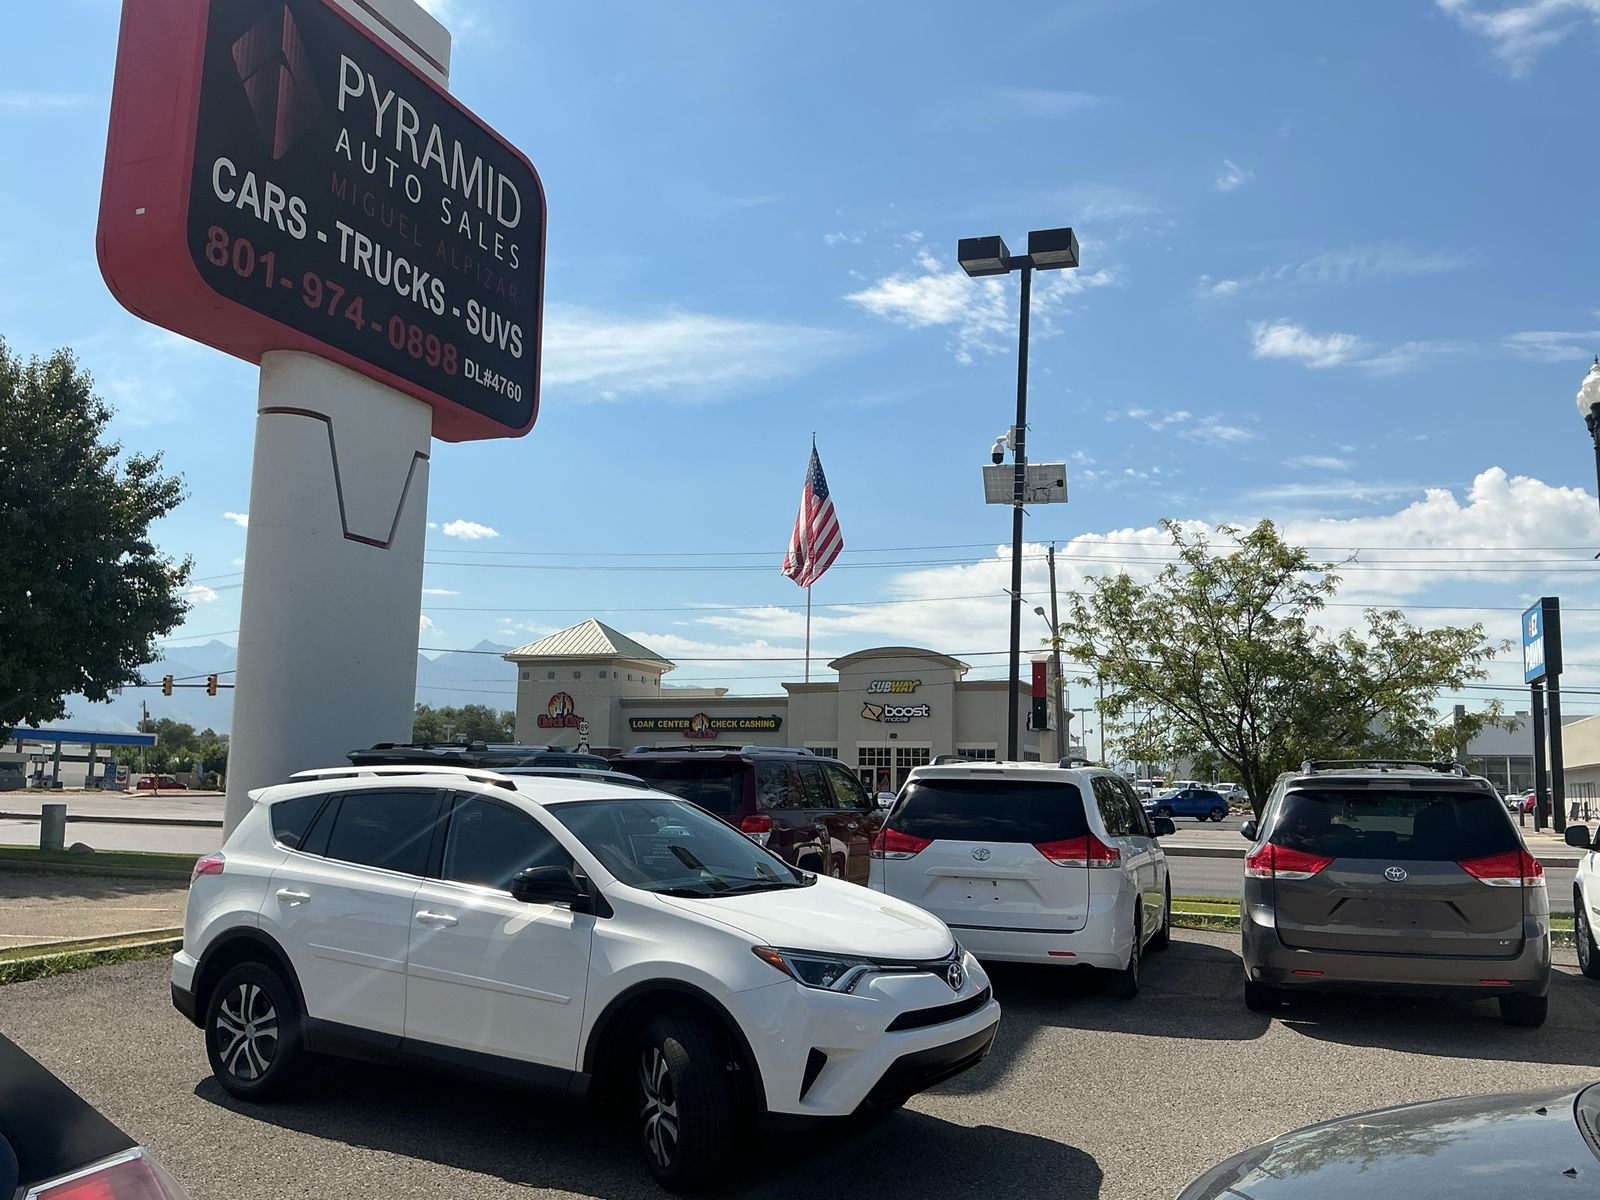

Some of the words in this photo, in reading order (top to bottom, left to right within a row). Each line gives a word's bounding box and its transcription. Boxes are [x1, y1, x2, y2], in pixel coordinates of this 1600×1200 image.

[337, 54, 522, 229] PYRAMID
[334, 127, 422, 204] AUTO
[440, 196, 520, 270] SALES
[330, 172, 423, 247] MIGUEL
[436, 239, 519, 305] ALPIZAR
[212, 156, 307, 241] CARS
[335, 221, 446, 316] TRUCKS
[465, 299, 523, 359] SUVS
[464, 358, 522, 402] DL#4760
[1525, 634, 1545, 671] PAWN
[867, 679, 921, 693] SUBWAY
[538, 714, 565, 728] Check
[884, 705, 929, 717] boost
[581, 723, 588, 732] 89
[633, 720, 654, 728] LOAN
[658, 720, 690, 728] CENTER
[711, 720, 738, 728] CHECK
[739, 720, 775, 728] CASHING
